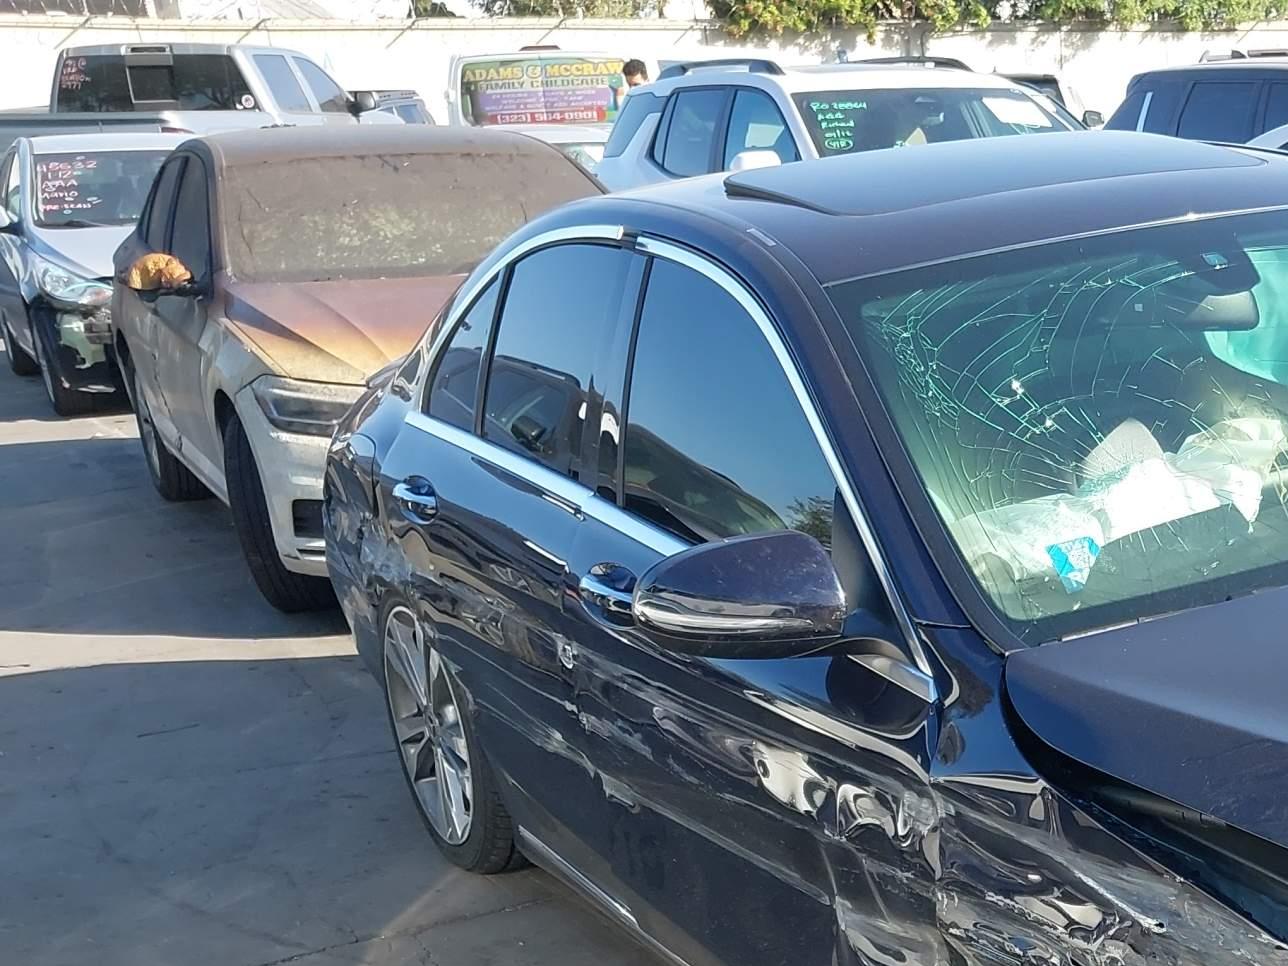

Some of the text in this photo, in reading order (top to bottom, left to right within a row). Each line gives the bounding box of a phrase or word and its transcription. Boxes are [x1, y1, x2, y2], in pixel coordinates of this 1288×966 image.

[464, 61, 624, 81] ADAMS & MCCRAW
[479, 78, 608, 91] FAMILY CHILDCARE
